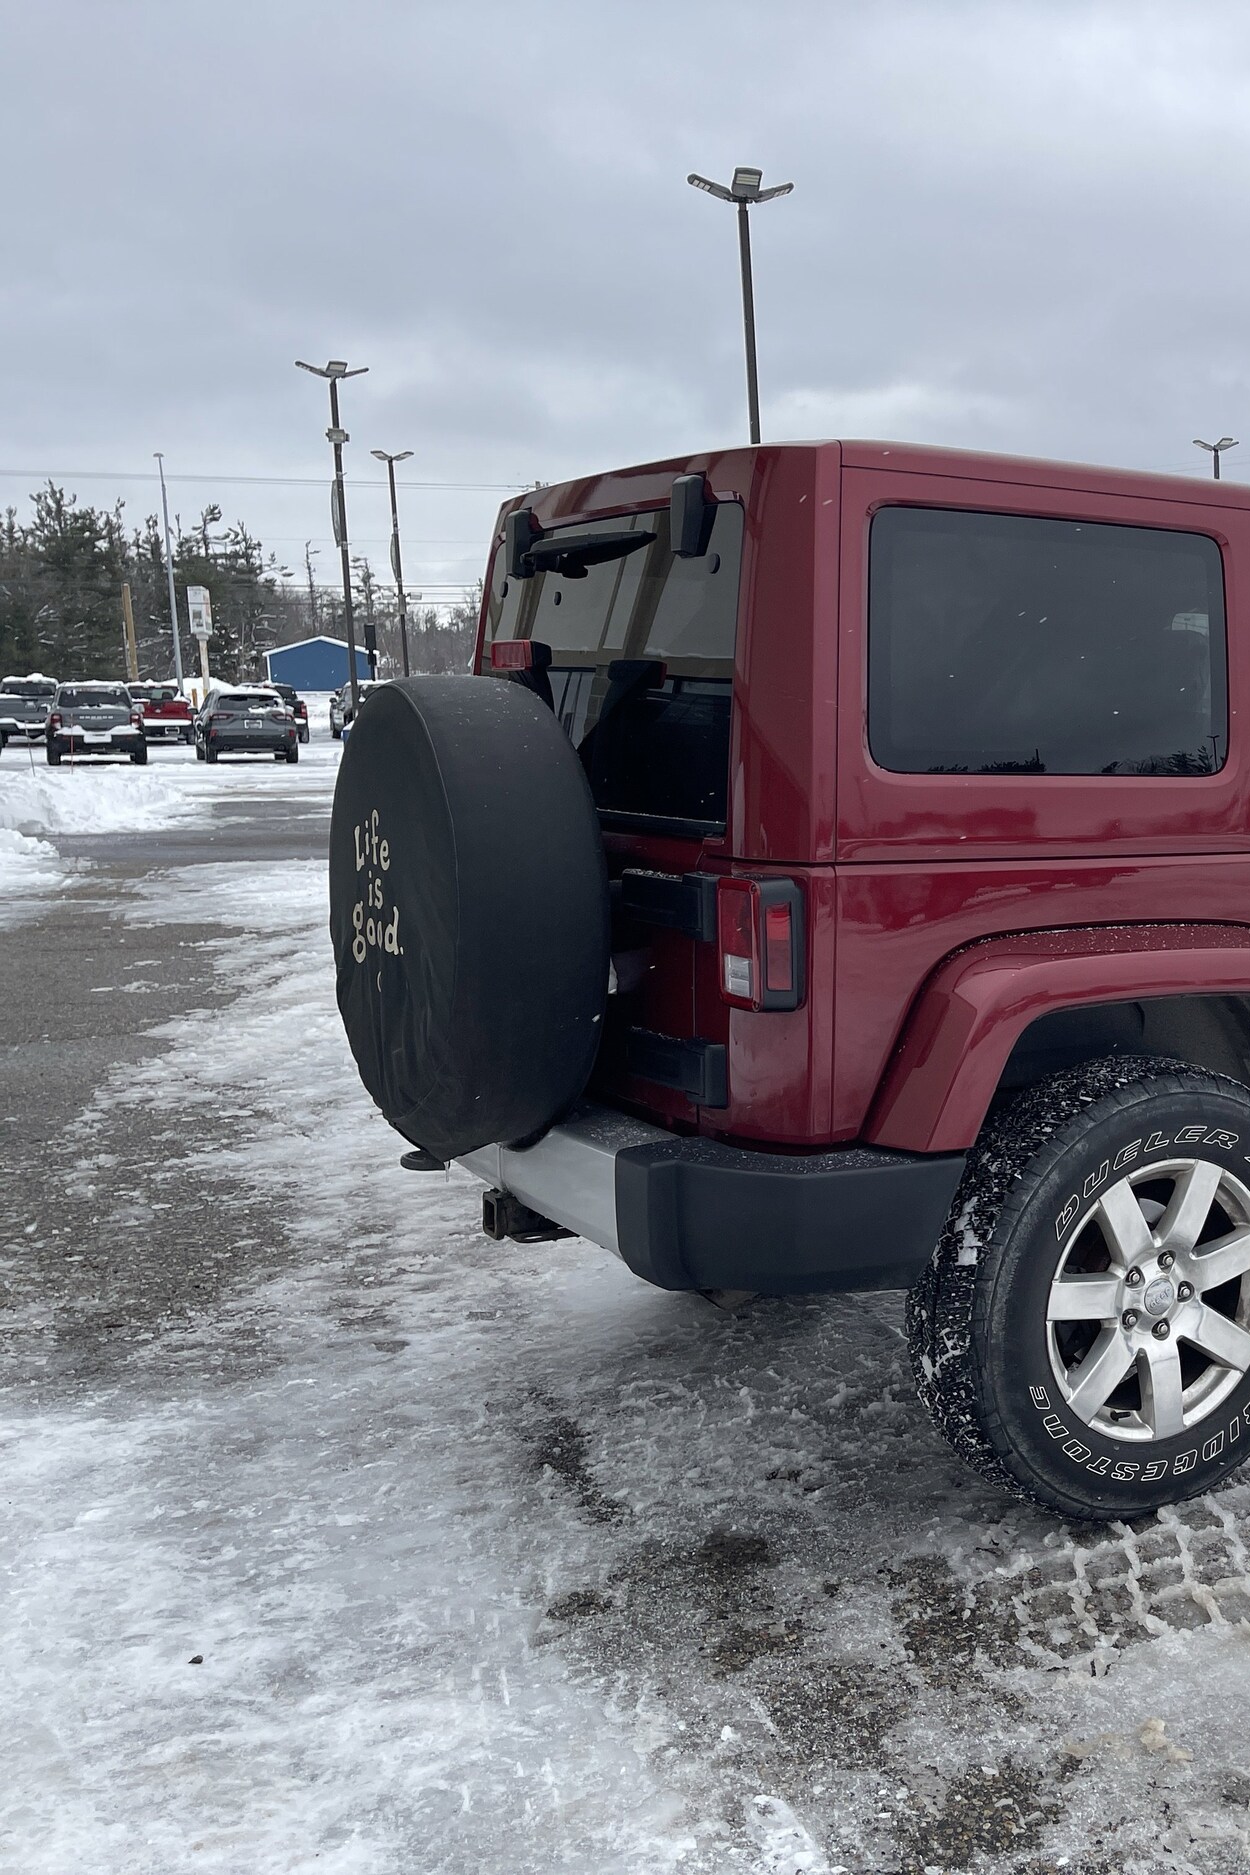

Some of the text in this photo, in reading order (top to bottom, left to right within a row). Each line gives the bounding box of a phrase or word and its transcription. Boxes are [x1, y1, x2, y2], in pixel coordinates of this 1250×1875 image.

[353, 809, 390, 872] Life
[368, 870, 384, 910] is
[1055, 1125, 1240, 1242] DUELER
